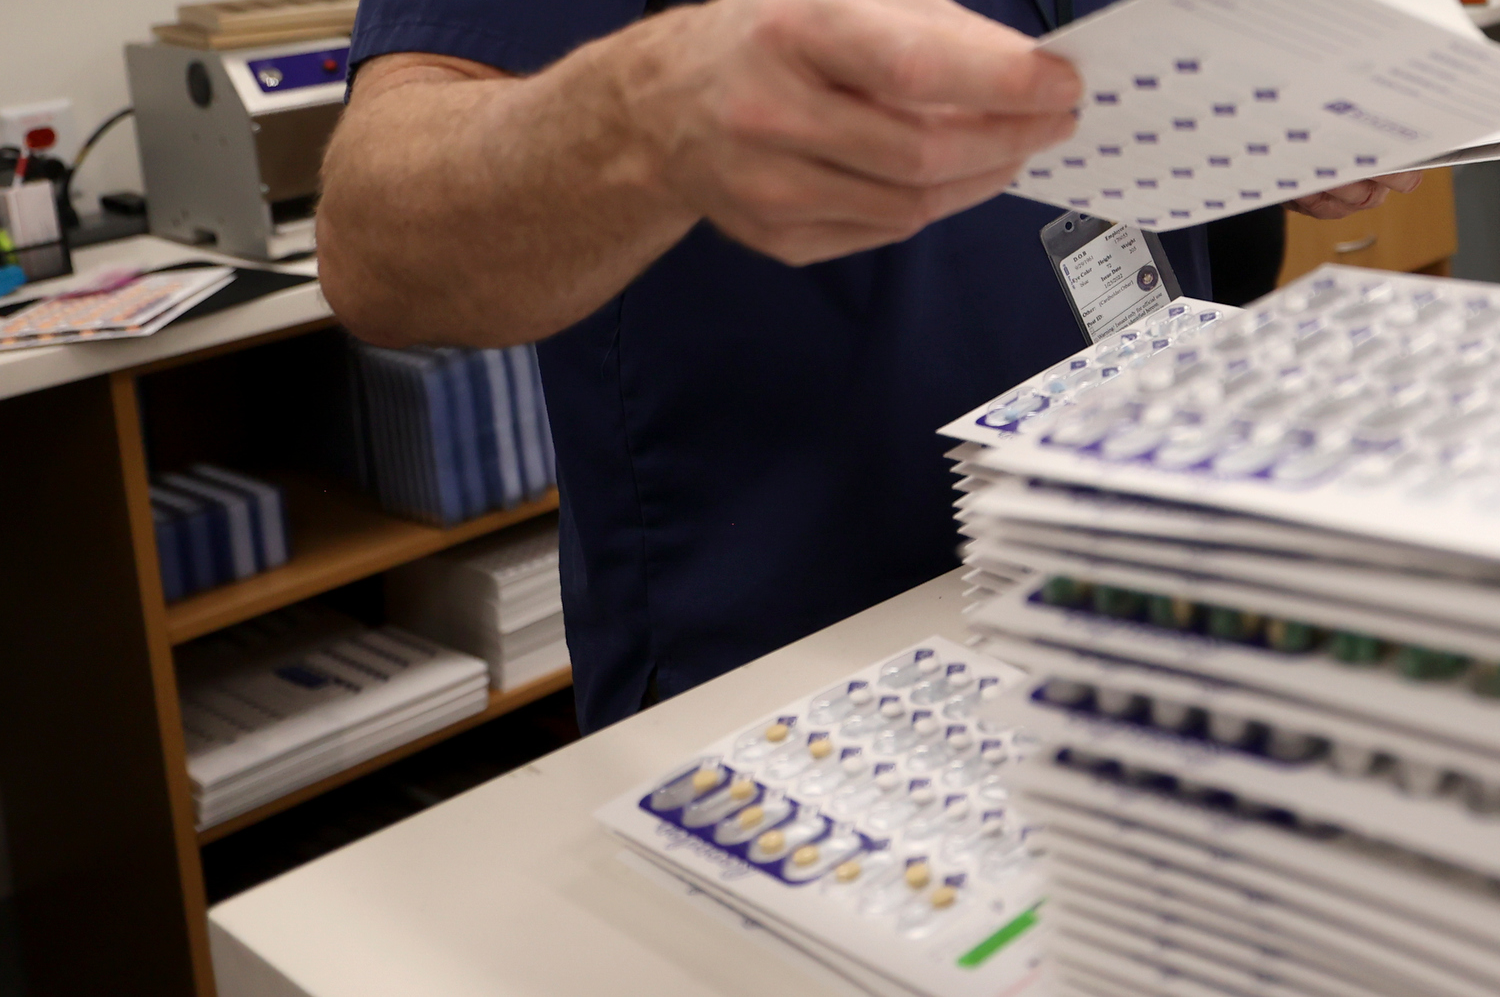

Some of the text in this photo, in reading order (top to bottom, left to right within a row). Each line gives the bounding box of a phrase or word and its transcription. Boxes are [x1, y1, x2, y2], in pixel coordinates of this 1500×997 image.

[1105, 227, 1125, 241] Employee
[1121, 238, 1137, 249] Weight
[1097, 254, 1112, 266] Height
[1072, 267, 1093, 283] Eye Color
[1101, 266, 1122, 282] Issue Date
[1087, 319, 1096, 328] Post
